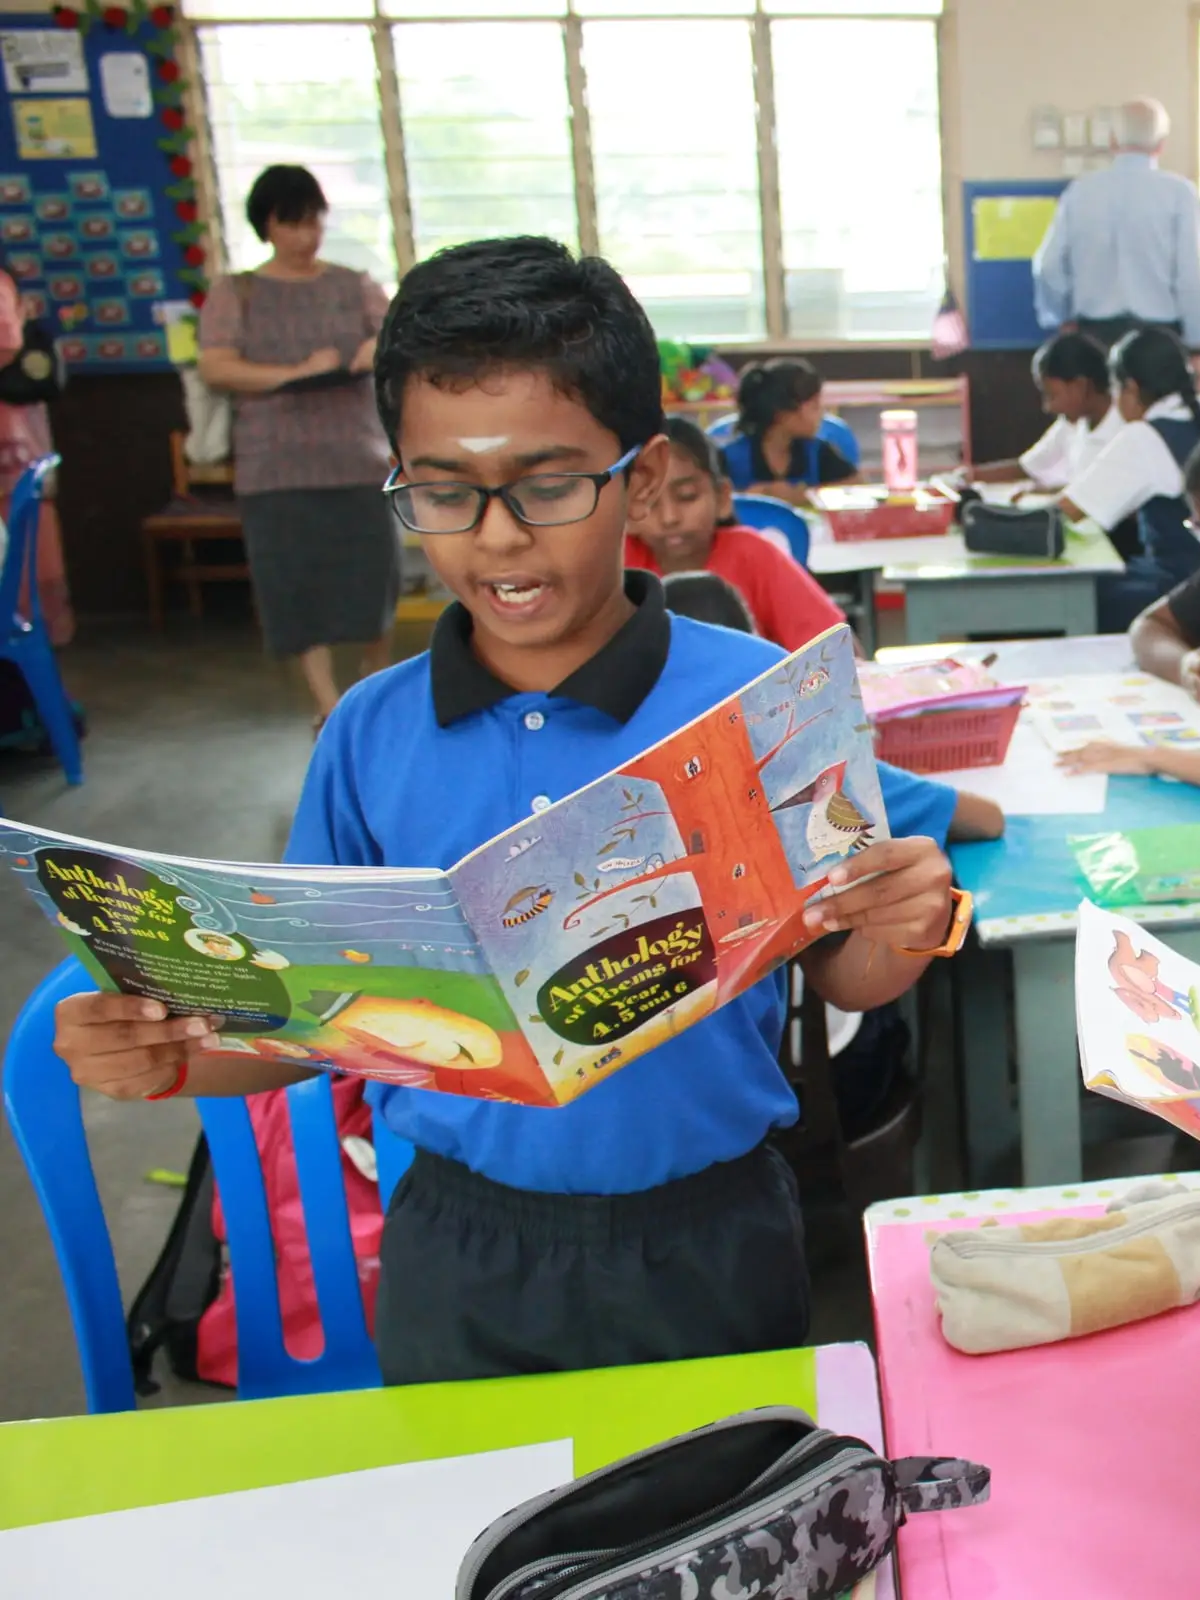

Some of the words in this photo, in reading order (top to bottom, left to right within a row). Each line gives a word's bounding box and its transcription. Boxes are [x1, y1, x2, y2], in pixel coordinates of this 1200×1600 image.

[45, 859, 174, 915] Anthology
[62, 886, 80, 899] of
[72, 883, 145, 915] Poems
[148, 910, 176, 925] for
[98, 906, 139, 923] Year
[129, 928, 157, 939] and
[549, 921, 703, 1013] Anthology
[564, 1004, 586, 1024] of
[582, 963, 667, 1007] Poems
[670, 951, 702, 969] for
[610, 983, 662, 1010] Year
[639, 990, 672, 1012] and
[674, 981, 688, 993] 6
